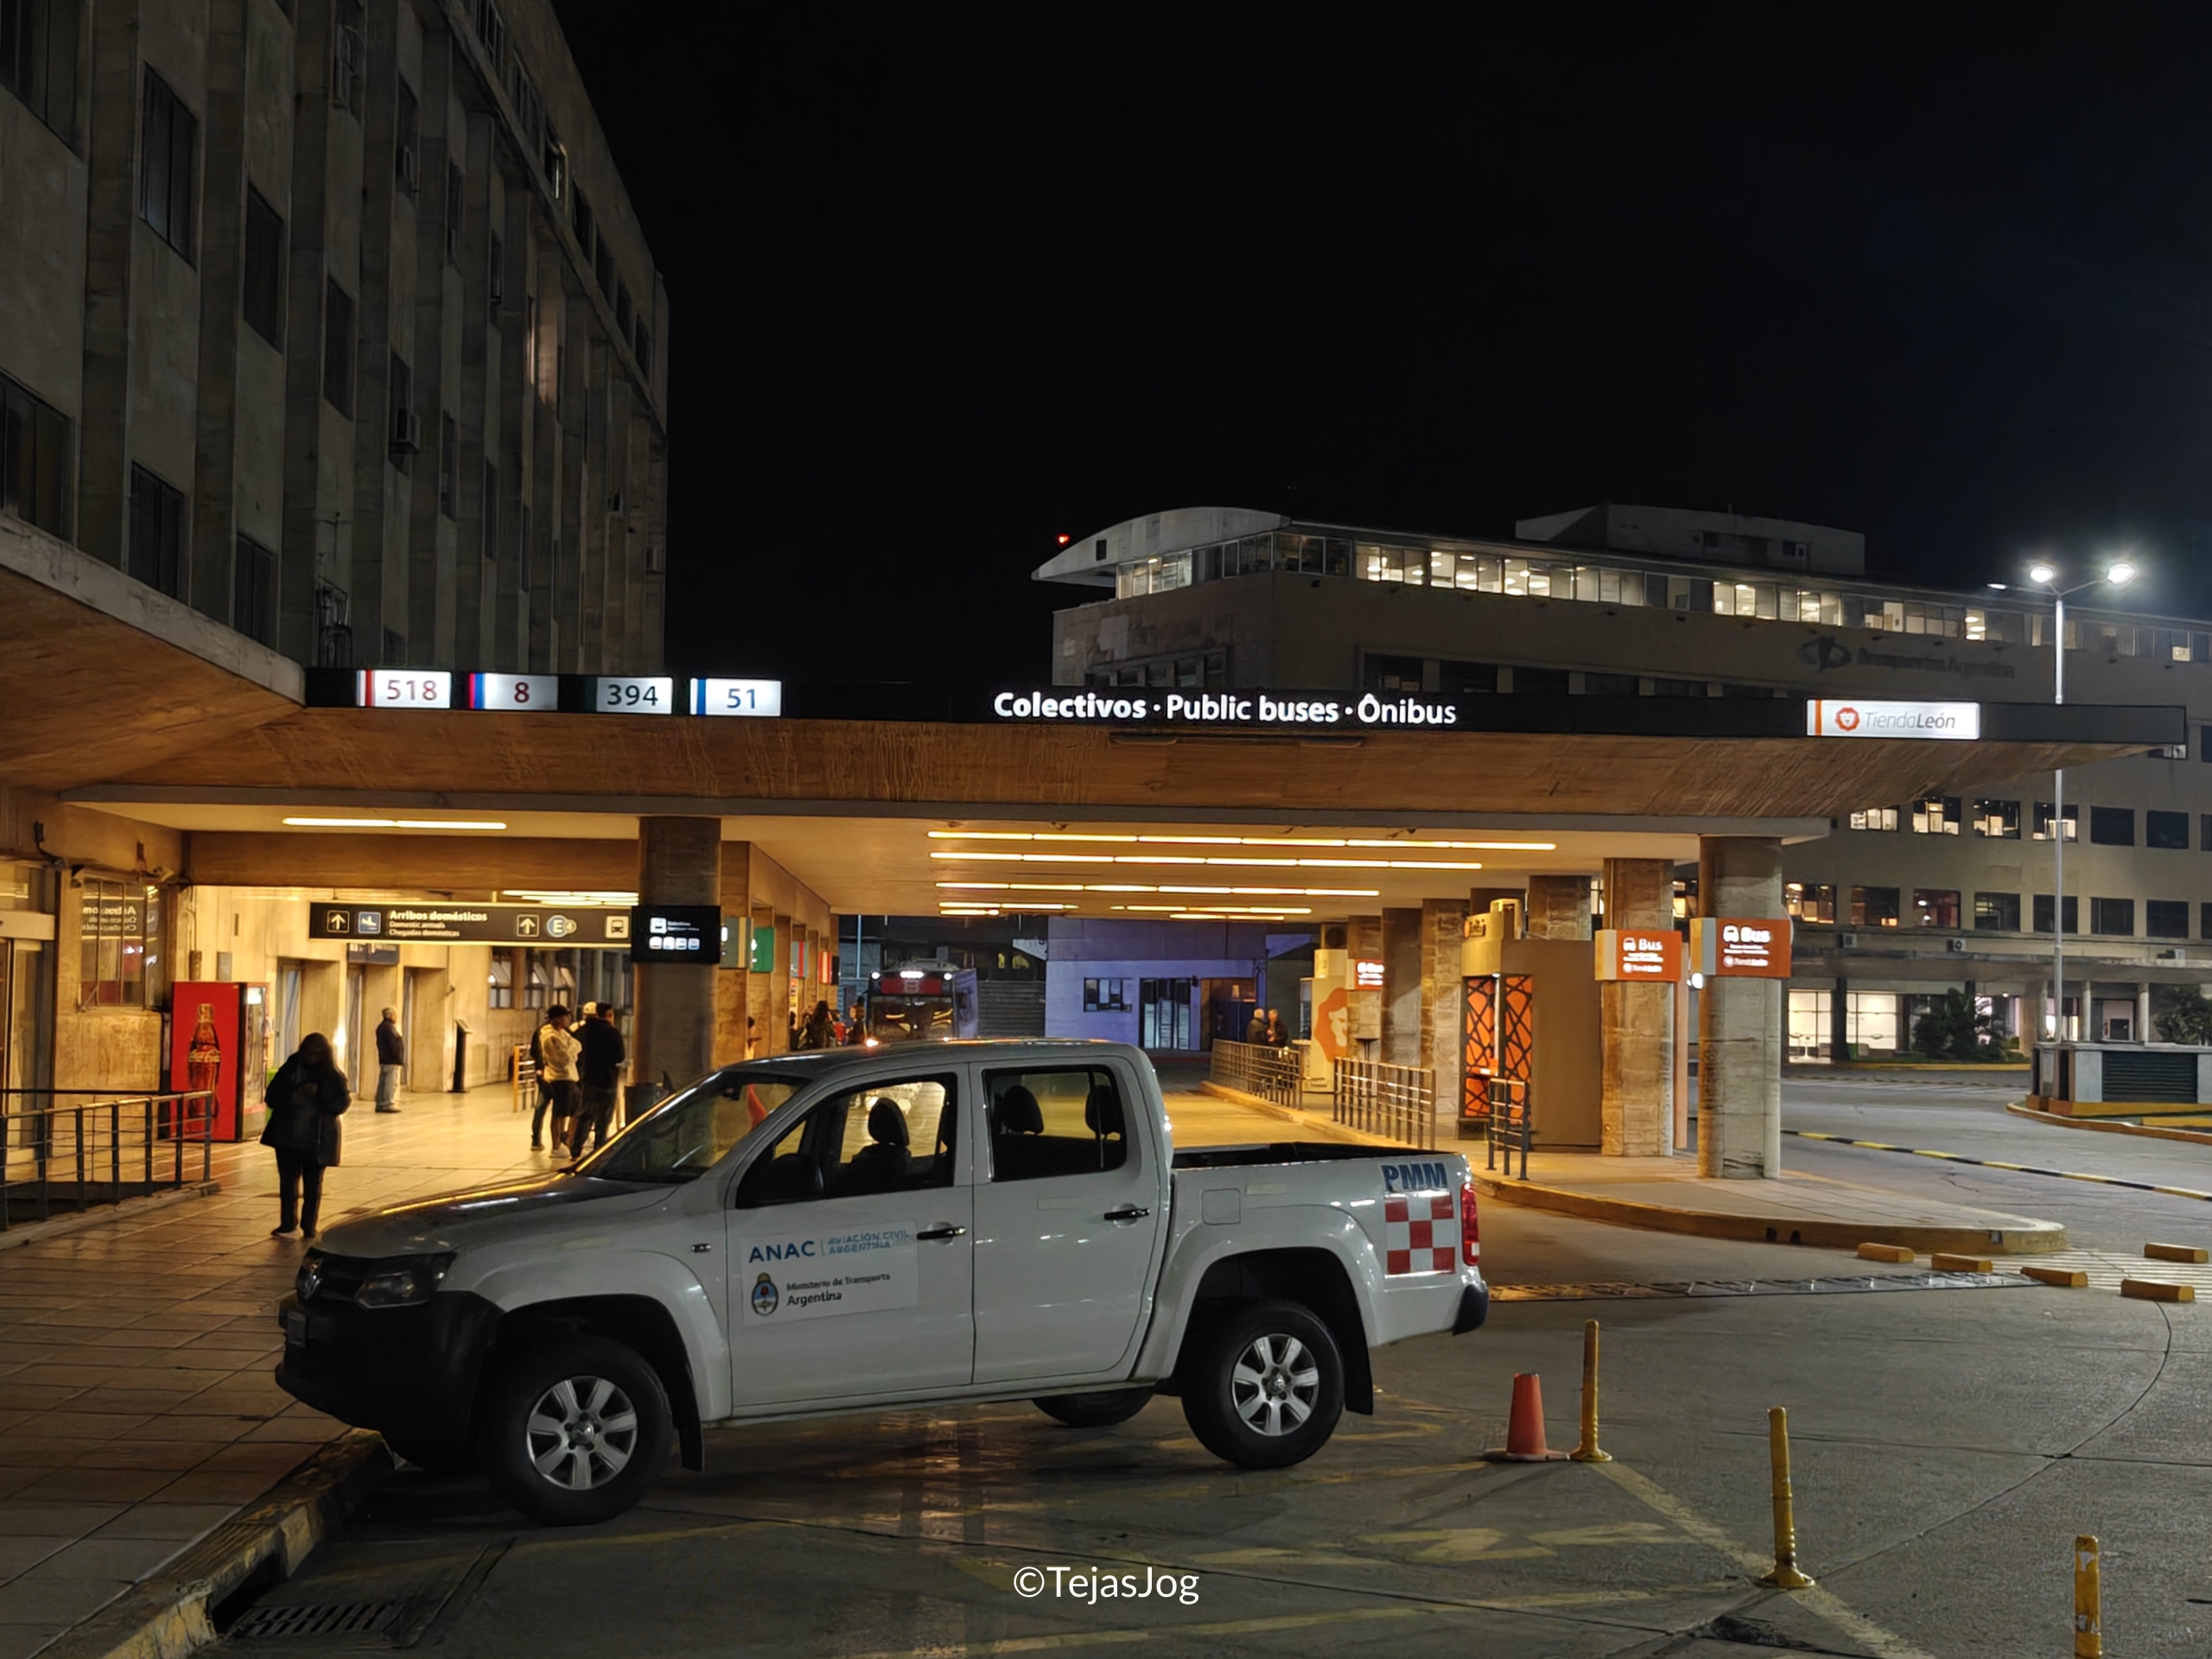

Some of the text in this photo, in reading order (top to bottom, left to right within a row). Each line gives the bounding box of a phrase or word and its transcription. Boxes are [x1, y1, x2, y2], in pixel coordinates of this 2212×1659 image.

[387, 679, 438, 701] 518
[514, 682, 530, 703] 8
[607, 684, 658, 707] 394
[727, 688, 756, 709] 51
[994, 692, 1458, 724] Colectivos Public buses Ônibus
[390, 910, 488, 921] Arribos domésticos
[553, 919, 563, 933] E
[1638, 938, 1663, 951] Bus
[1740, 926, 1771, 943] Bus
[1381, 1162, 1448, 1192] PMM
[748, 1240, 817, 1263] ANAC
[833, 1277, 843, 1287] de
[786, 1291, 842, 1308] Argentina
